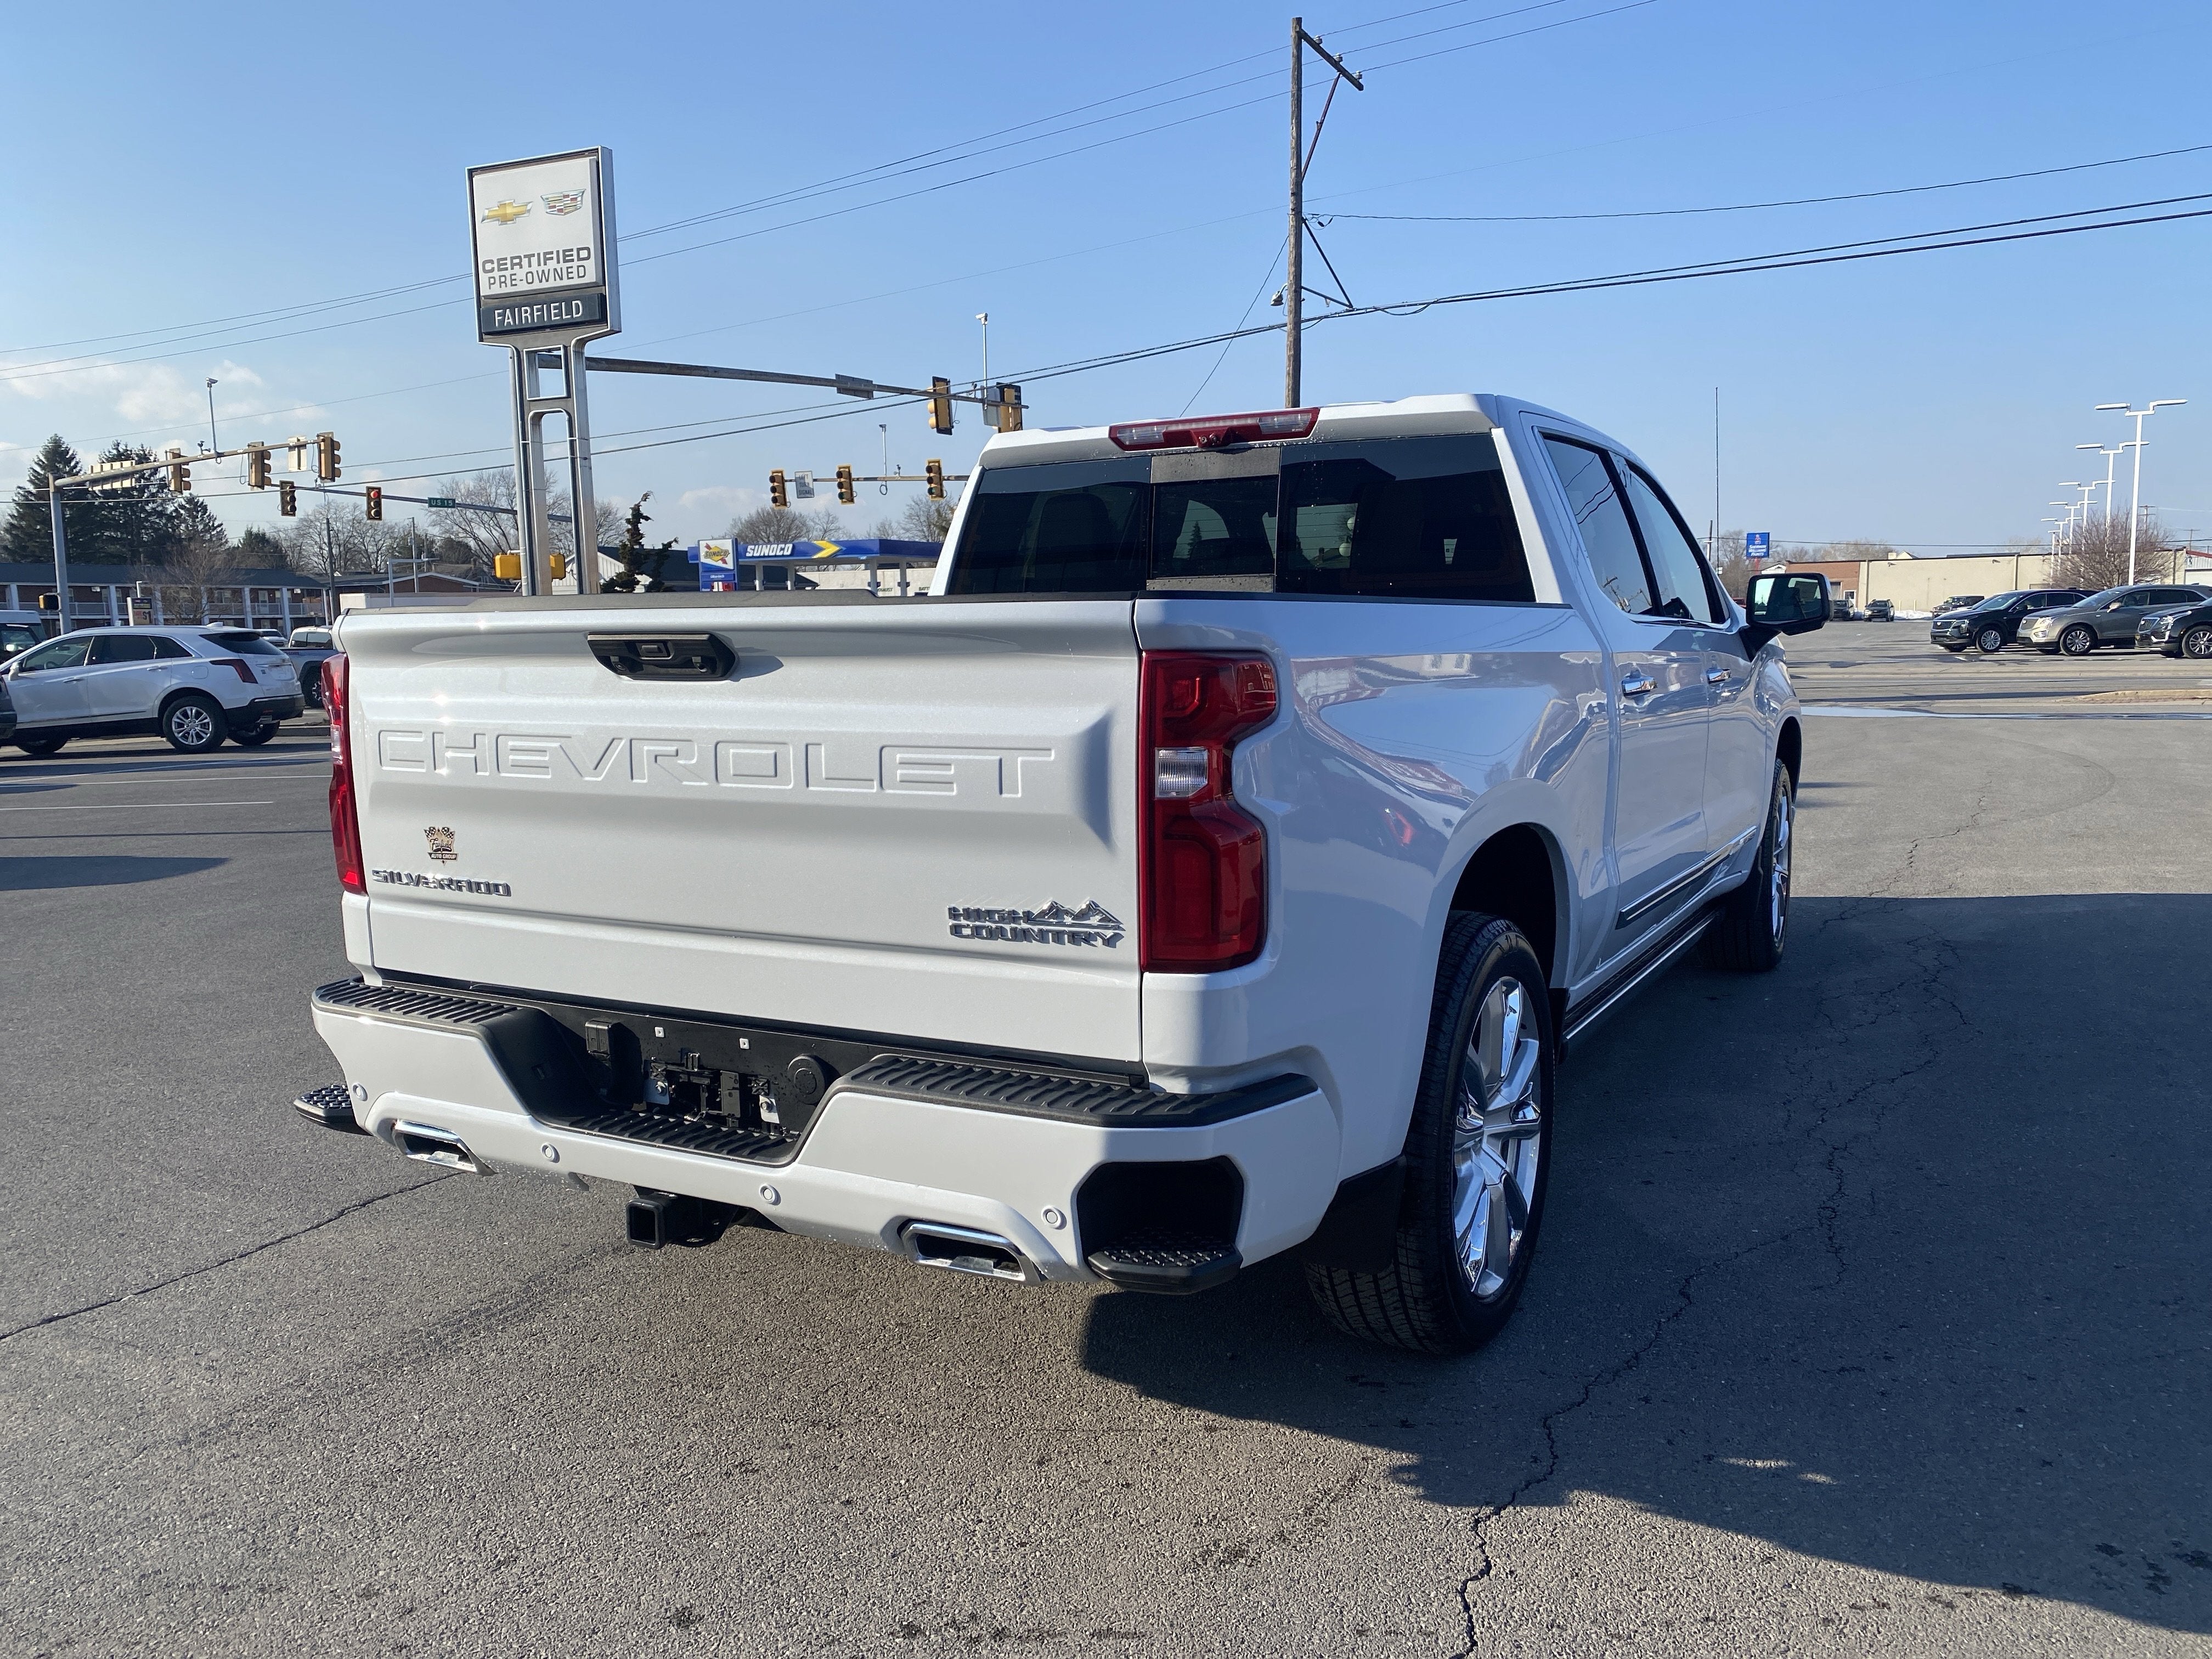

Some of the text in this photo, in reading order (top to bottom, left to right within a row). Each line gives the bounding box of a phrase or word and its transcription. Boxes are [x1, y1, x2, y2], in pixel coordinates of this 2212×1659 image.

[482, 246, 591, 274] CERTIFIED
[488, 264, 586, 290] PRE-OWNED
[494, 300, 584, 328] FAIRFIELD
[704, 550, 729, 558] SUNOCO
[746, 544, 793, 557] SUNOCO
[378, 730, 1056, 798] CHEVROLET
[372, 868, 512, 897] SILVERADO
[947, 904, 1036, 924] HIGH
[949, 923, 1125, 949] COUNTRY
